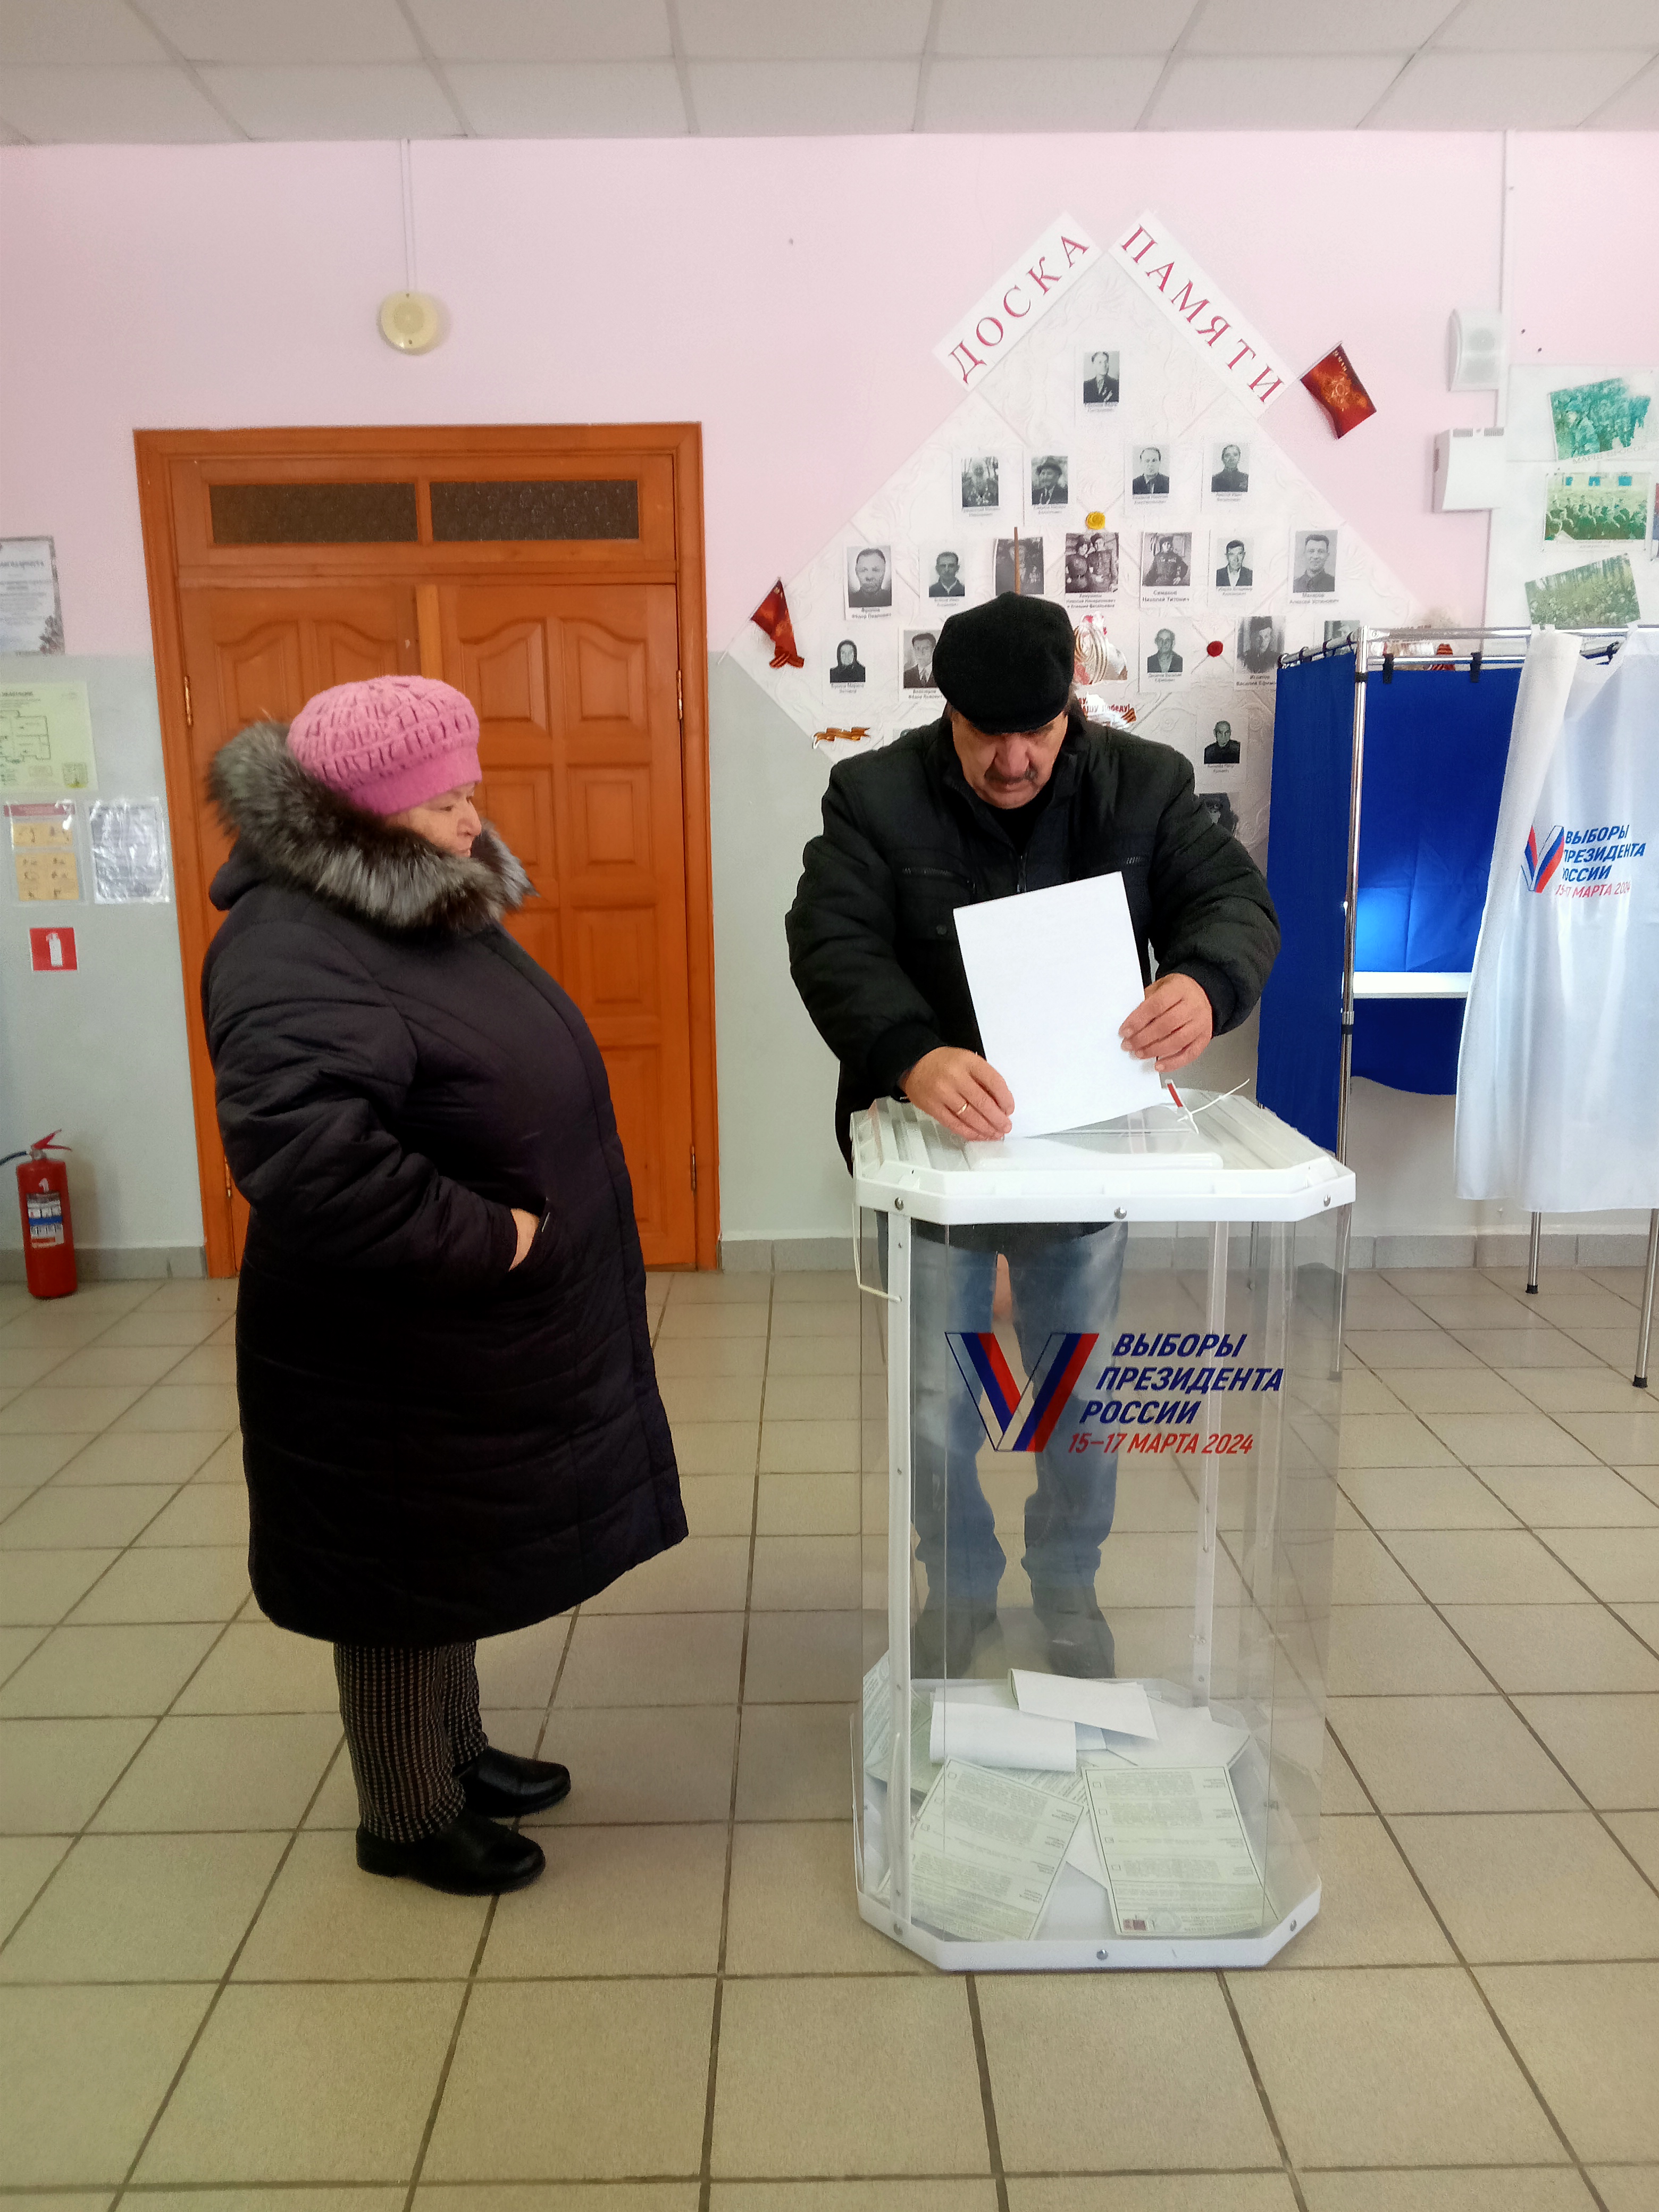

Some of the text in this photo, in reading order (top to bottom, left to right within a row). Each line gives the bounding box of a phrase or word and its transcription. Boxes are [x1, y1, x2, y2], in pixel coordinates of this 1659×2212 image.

[948, 224, 1285, 404] ДОСКА ПАМЯТИ
[1565, 824, 1630, 845] ВЫБОРЫ
[1572, 883, 1612, 898] МАРТА
[1112, 1333, 1247, 1358] ВЫБОРЫ
[1095, 1367, 1284, 1395] ПРЕЗИДЕНТА
[1079, 1401, 1201, 1425] РОССИИ
[1127, 1434, 1197, 1454] МАРТА
[1201, 1434, 1254, 1455] 2024
